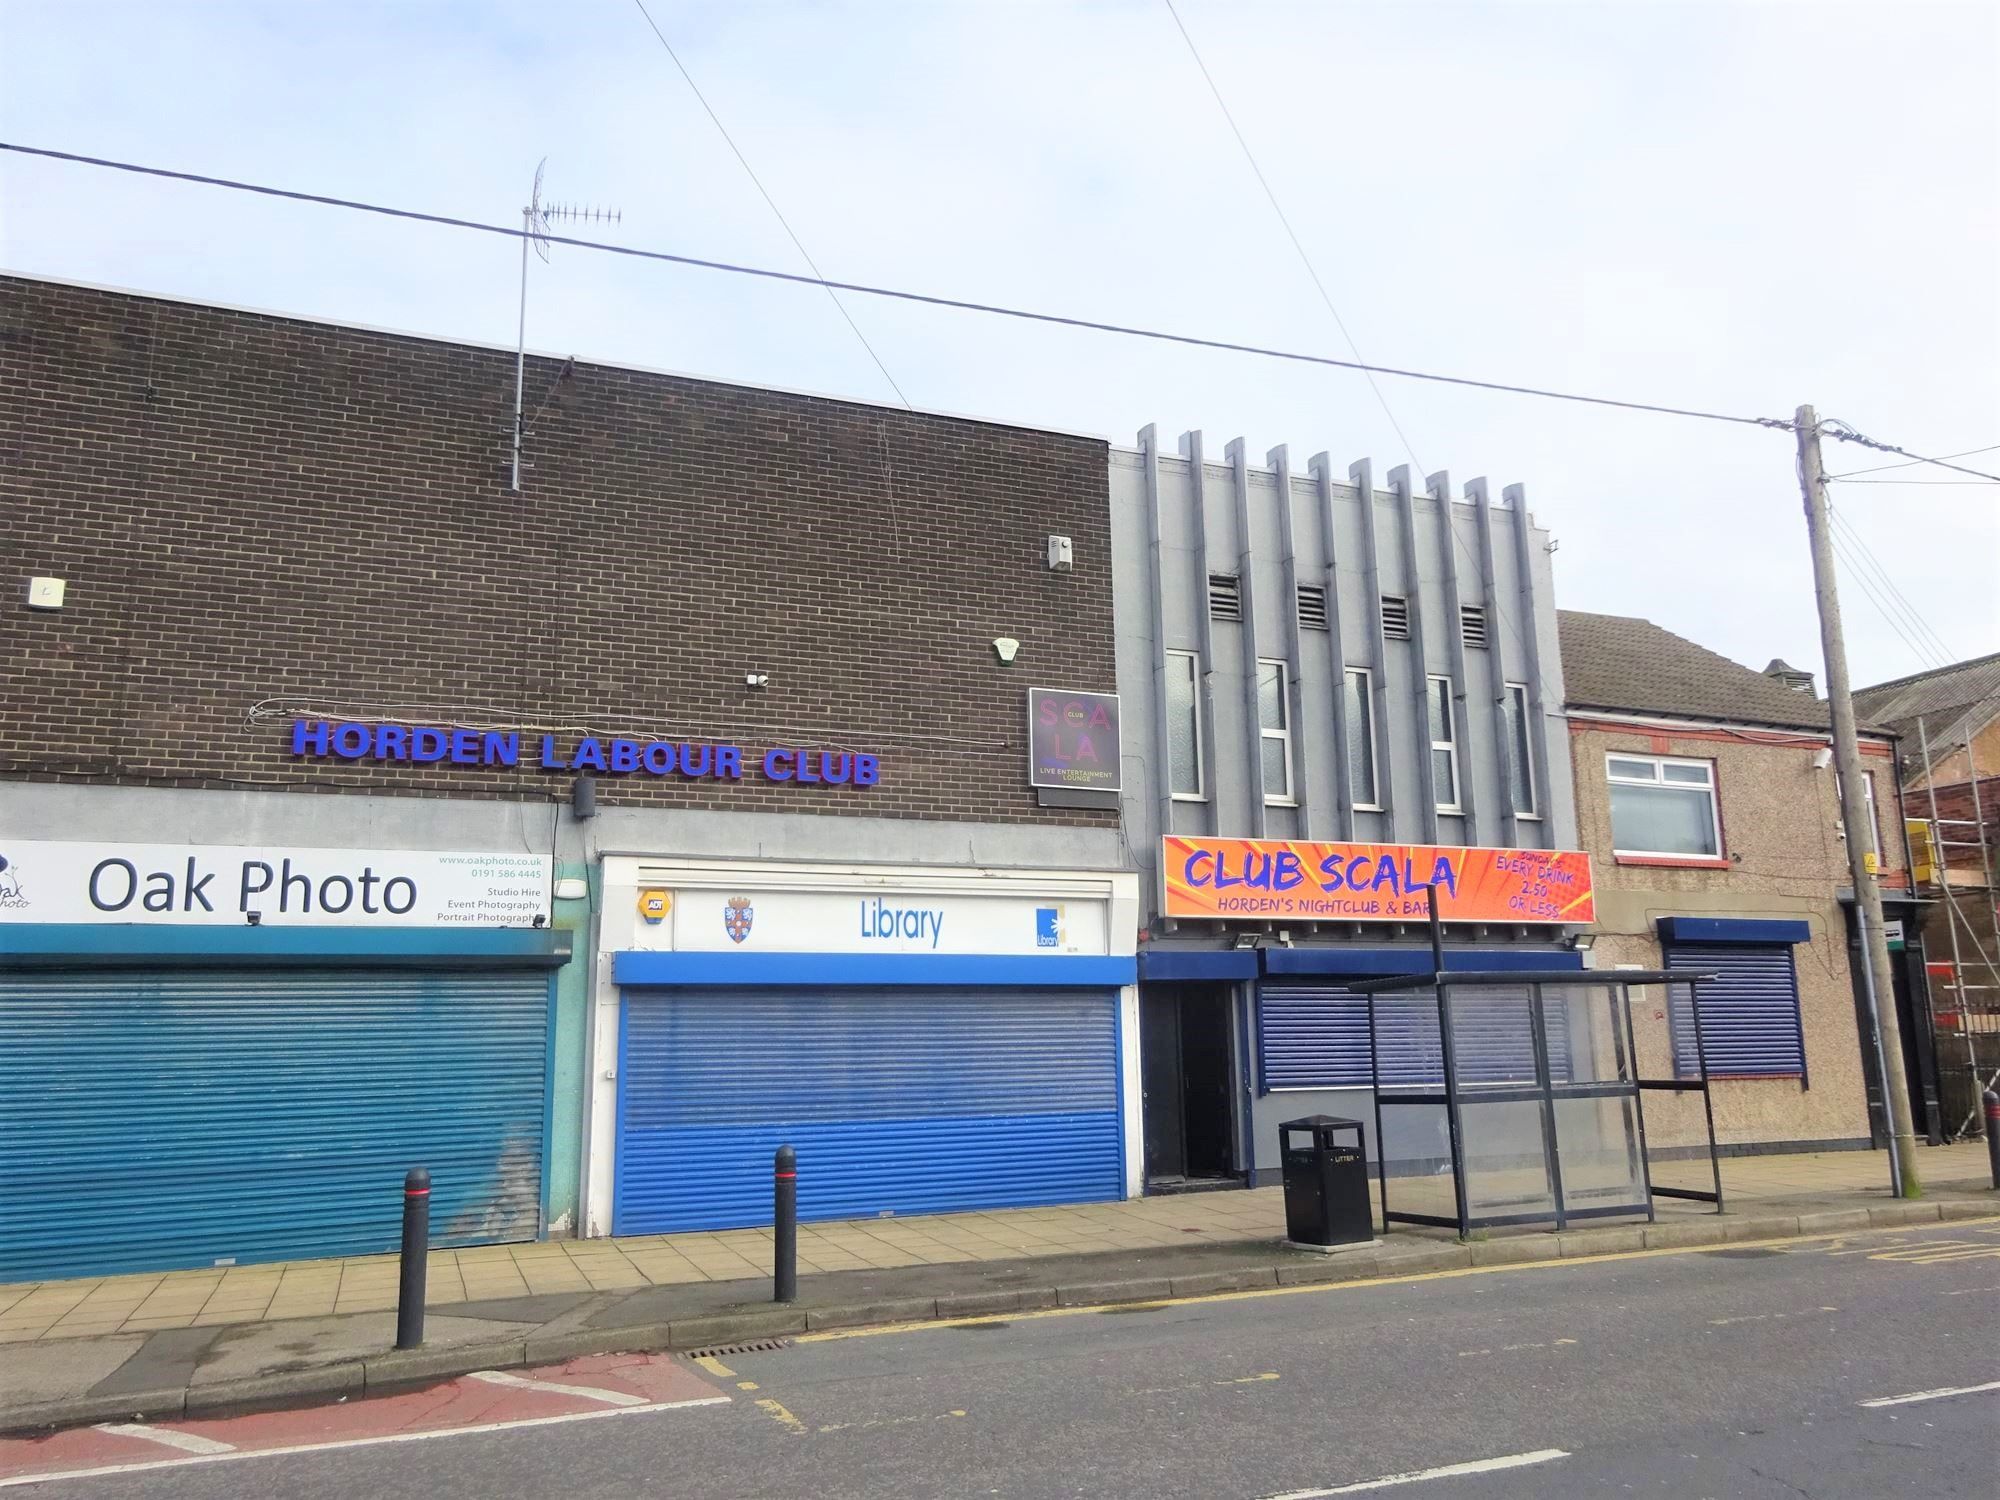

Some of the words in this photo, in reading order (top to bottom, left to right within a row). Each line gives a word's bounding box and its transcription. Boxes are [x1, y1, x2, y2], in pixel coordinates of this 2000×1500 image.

[1067, 711, 1084, 719] CLUB
[291, 720, 520, 767] HORDEN
[541, 735, 743, 778] LABOUR
[762, 749, 882, 786] CLUB
[1040, 767, 1056, 775] LIVE
[1057, 768, 1113, 779] ENTERTAINMENT
[439, 856, 542, 866] www.oakphoto.co.uk
[471, 869, 495, 878] 0191
[498, 870, 516, 878] 586
[518, 871, 542, 879] 4445
[1184, 849, 1304, 892] CLUB
[1319, 854, 1457, 899] SCALA
[1496, 855, 1534, 877] EVERY
[1538, 866, 1573, 884] DRINK
[88, 856, 215, 912] Oak
[239, 858, 418, 913] Photo
[1522, 880, 1548, 897] 2.50
[487, 888, 519, 896] Studio
[521, 888, 541, 896] Hire
[447, 900, 475, 909] Event
[477, 901, 541, 910] Photography
[649, 900, 662, 909] ADT
[1218, 897, 1294, 914] HORDEN'S
[1299, 899, 1380, 915] NIGHTCLUB
[1386, 902, 1398, 915] &
[1403, 901, 1431, 915] BAR
[1509, 896, 1526, 912] OR
[1529, 901, 1560, 919] LESS
[437, 913, 474, 921] Portrait
[477, 913, 537, 924] Photograph
[861, 897, 944, 949] Library
[1037, 934, 1058, 947] Library
